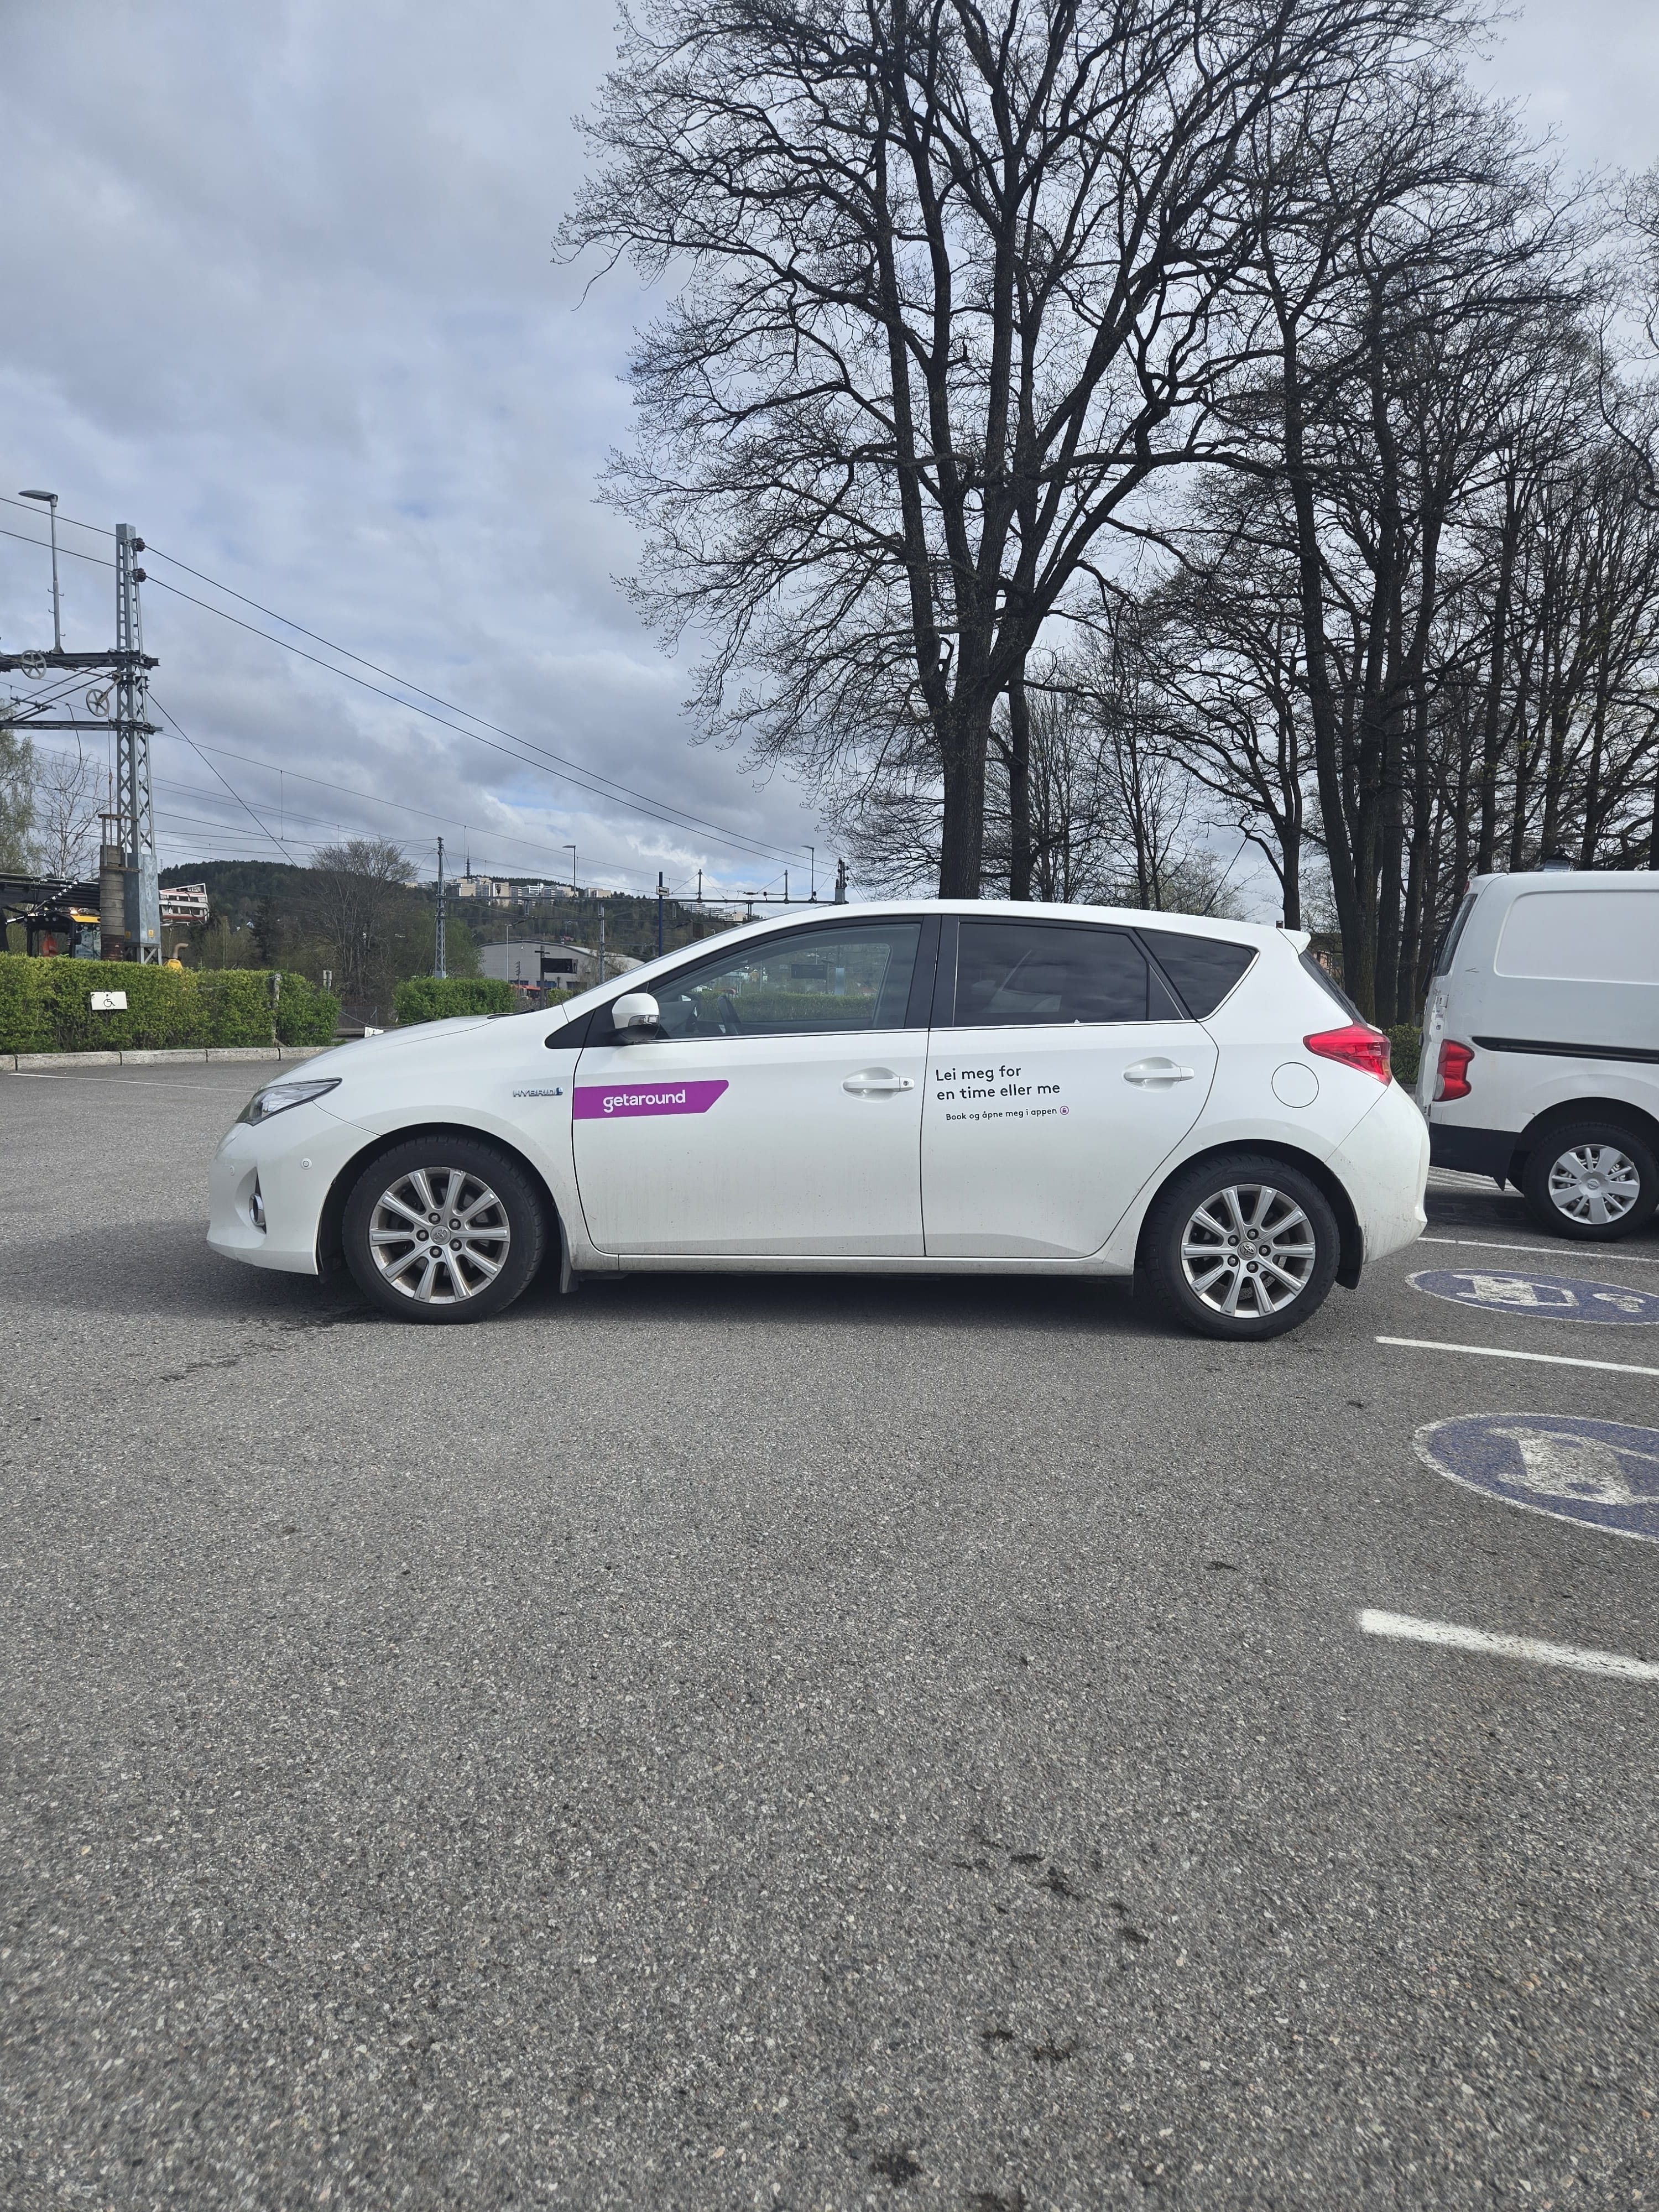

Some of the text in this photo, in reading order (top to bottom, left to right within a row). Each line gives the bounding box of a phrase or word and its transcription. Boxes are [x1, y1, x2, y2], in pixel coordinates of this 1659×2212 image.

[936, 1065, 1021, 1082] Lei meg for
[513, 1089, 556, 1098] HYBRID
[937, 1084, 1060, 1100] en time eller me
[603, 1089, 686, 1113] getaround
[982, 1111, 1003, 1120] åpne
[1031, 1108, 1057, 1117] appen
